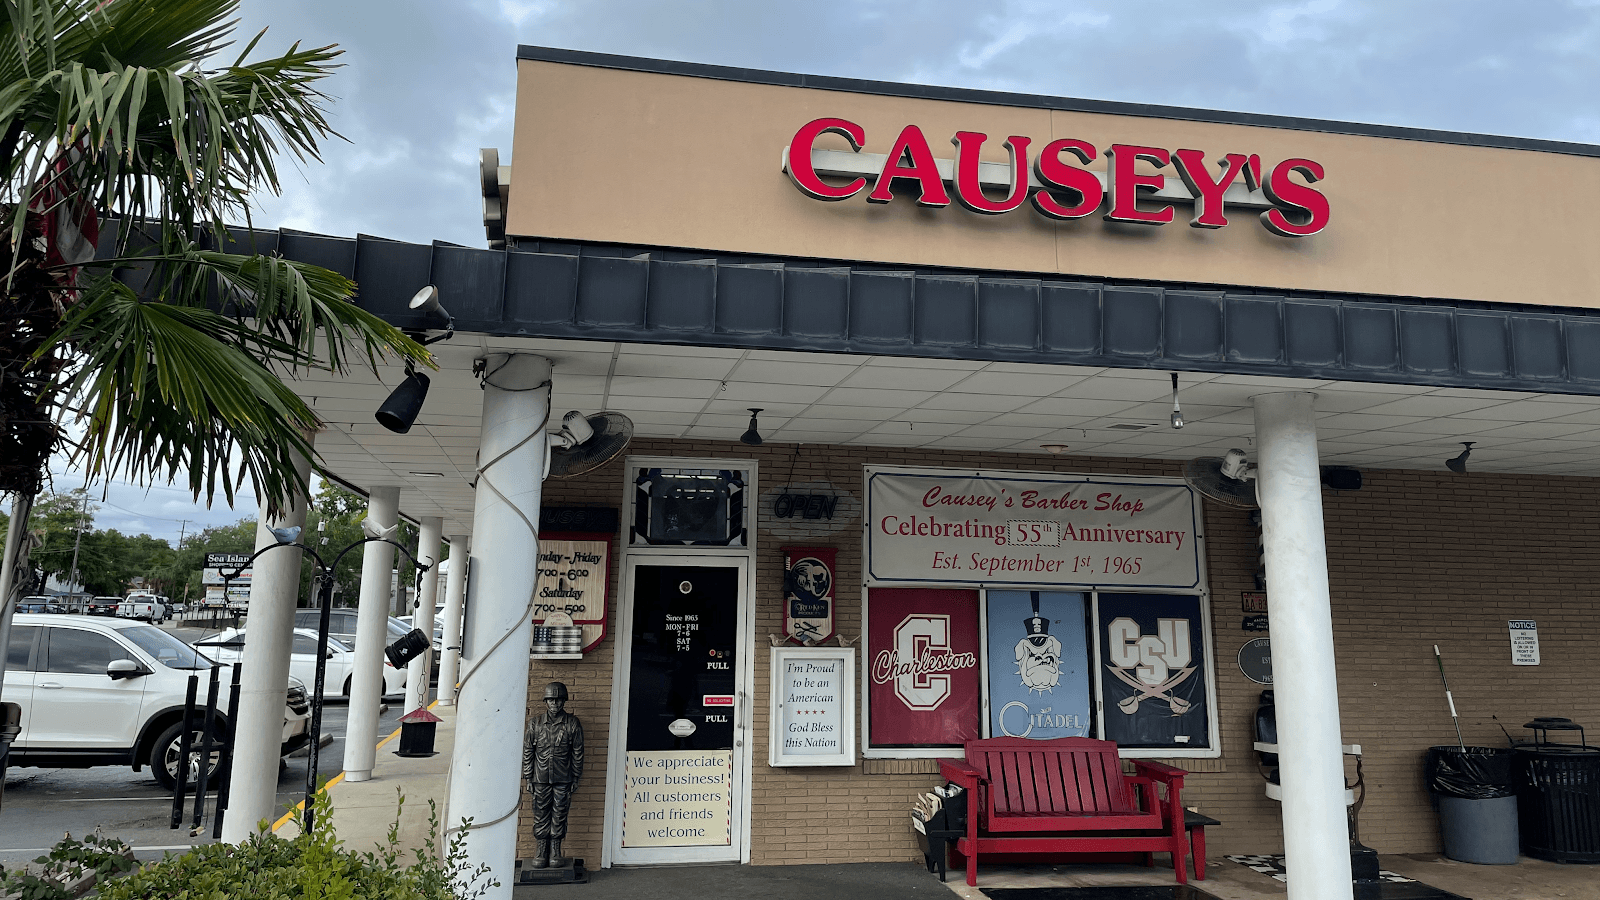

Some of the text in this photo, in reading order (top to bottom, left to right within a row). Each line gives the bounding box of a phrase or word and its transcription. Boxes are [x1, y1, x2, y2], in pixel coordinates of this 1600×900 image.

[786, 117, 1330, 236] CAUSEY'S
[922, 485, 1145, 516] Causey's Barber Shop
[775, 494, 838, 520] OPEN
[881, 515, 1186, 550] Celebrating 55th Anniversary
[208, 554, 250, 563] Sea Islan
[539, 551, 563, 564] nday
[569, 552, 602, 565] Friday
[932, 551, 1143, 576] Est. September 1st, 1965
[539, 587, 584, 600] Saturday
[666, 614, 683, 622] Since
[1108, 617, 1190, 688] CSU
[707, 662, 729, 670] PULL
[787, 662, 836, 673] I'm Proud
[872, 646, 977, 685] Charleston
[793, 677, 829, 688] to be an
[787, 692, 834, 703] American
[705, 715, 728, 723] PULL
[999, 701, 1084, 738] CITADEL
[789, 721, 834, 733] God Bless
[785, 737, 836, 748] this Nation
[633, 755, 724, 770] We appreciate
[630, 773, 725, 788] your business!
[633, 791, 722, 803] All customers
[640, 808, 714, 820] and friends
[647, 826, 706, 838] welcome
